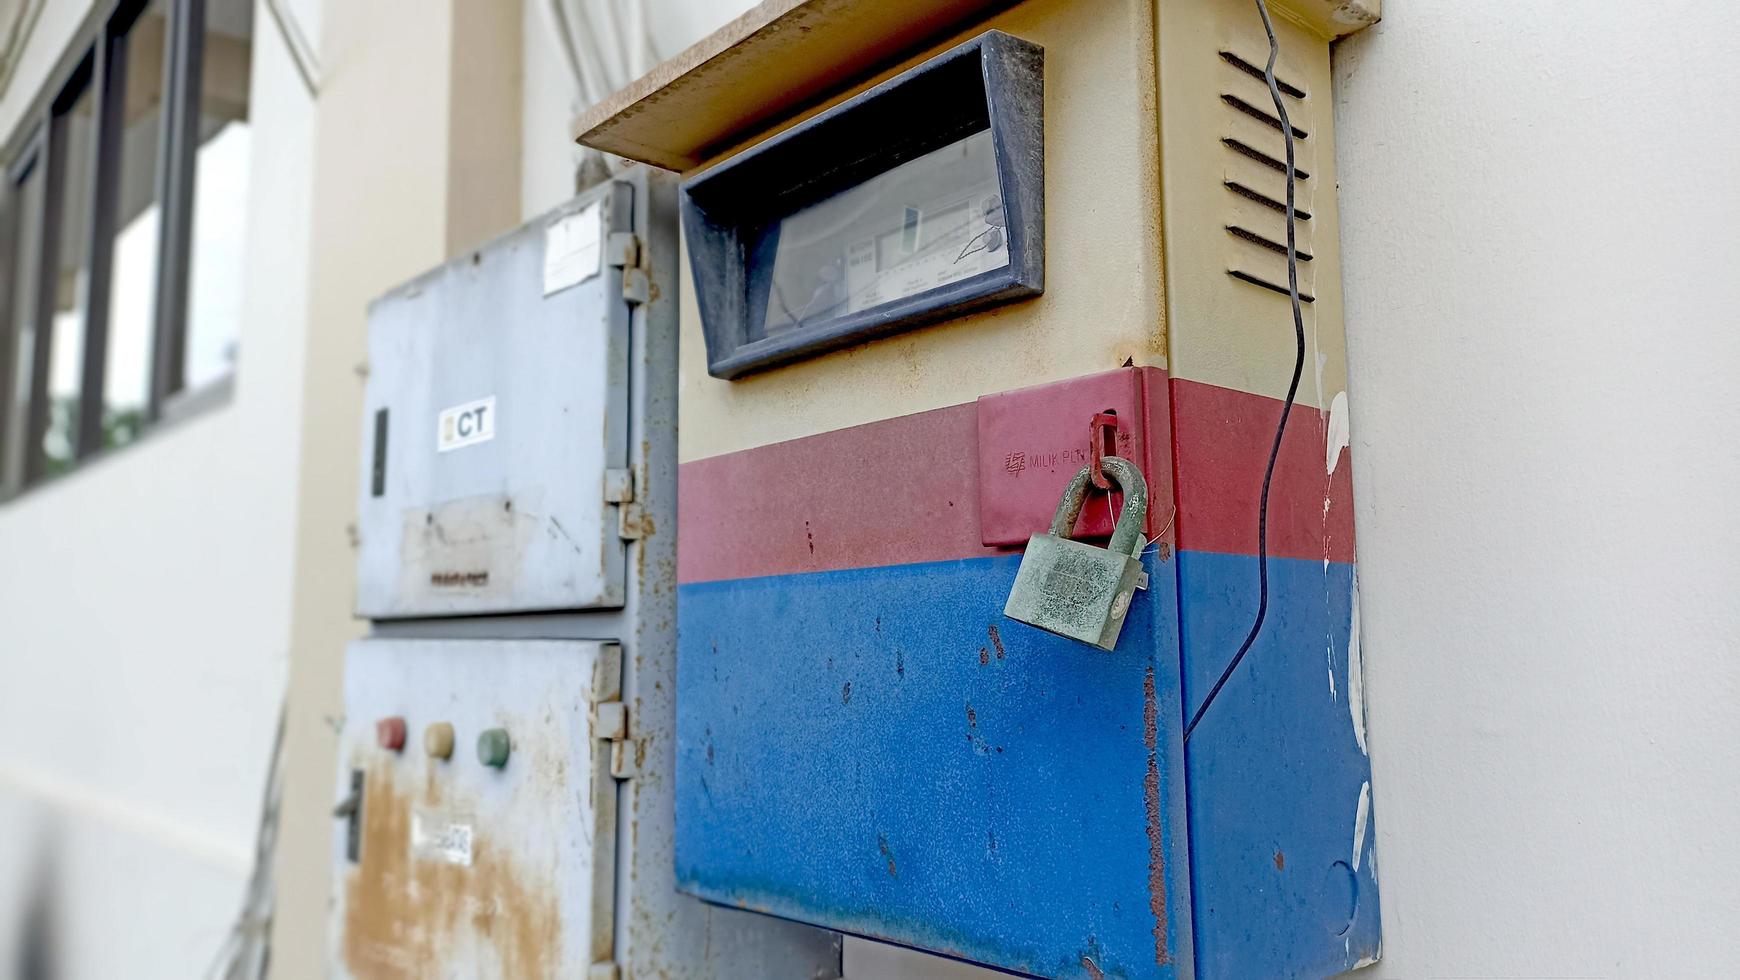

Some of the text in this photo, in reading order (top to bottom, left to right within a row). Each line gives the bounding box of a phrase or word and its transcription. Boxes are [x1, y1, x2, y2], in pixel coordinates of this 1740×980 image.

[457, 405, 487, 437] CT
[1029, 447, 1086, 468] MILIK PLN
